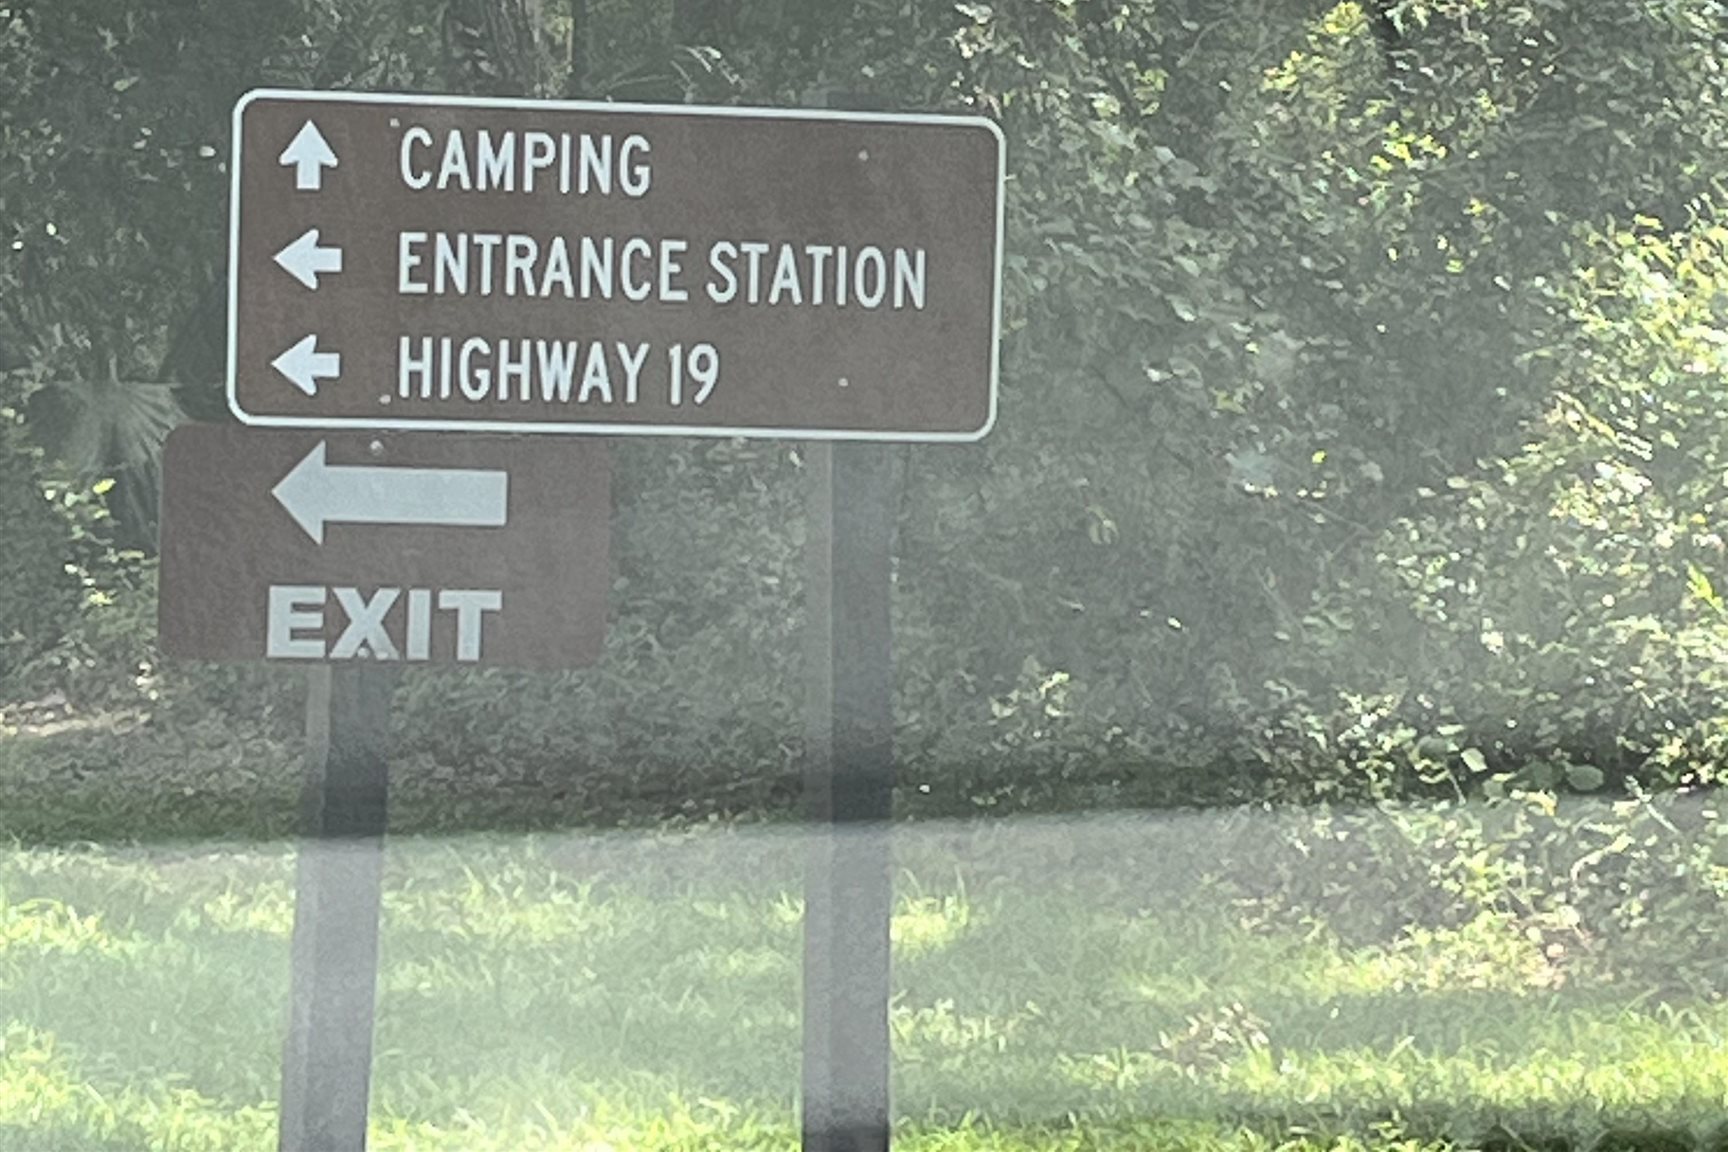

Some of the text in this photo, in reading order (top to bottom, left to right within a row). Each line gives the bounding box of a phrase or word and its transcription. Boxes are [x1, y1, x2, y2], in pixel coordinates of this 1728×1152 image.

[400, 127, 651, 197] CAMPING
[397, 231, 926, 310] ENTRANCE STATION
[398, 336, 720, 406] HIGHWAY 19
[266, 585, 503, 662] EXIT
